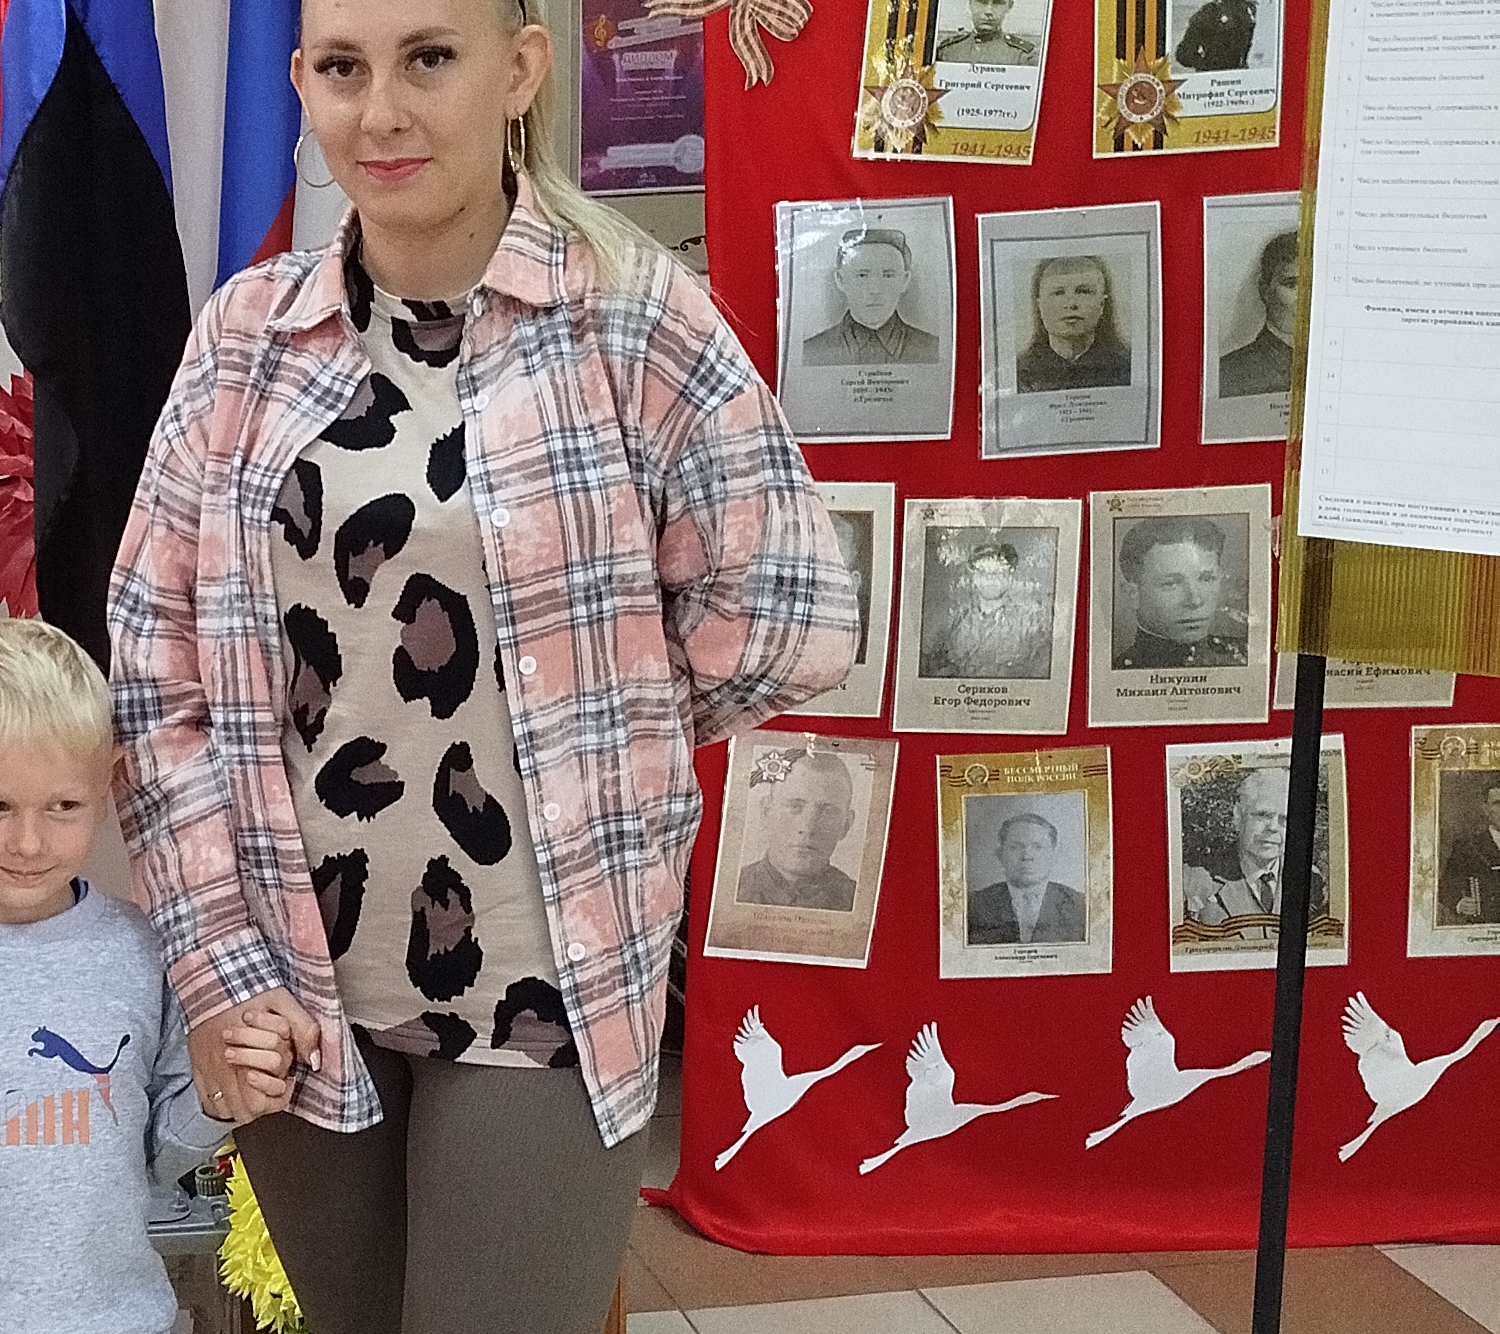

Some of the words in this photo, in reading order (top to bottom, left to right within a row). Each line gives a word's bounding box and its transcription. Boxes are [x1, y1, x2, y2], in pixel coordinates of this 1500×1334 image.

[939, 79, 982, 89] Григорий
[984, 81, 1031, 91] Сергеевич
[1177, 91, 1225, 100] Митрофан
[1227, 88, 1275, 98] Сергеевич
[1194, 126, 1276, 144] 1941-1945
[952, 142, 1032, 159] 1941-1945
[1325, 668, 1362, 676] насий
[1366, 667, 1430, 678] Ефимович
[1149, 674, 1207, 685] Никулин
[957, 684, 1008, 695] Сериков
[1116, 688, 1167, 697] Михаил
[1170, 686, 1241, 696] Антонович
[934, 696, 961, 707] Егор
[964, 696, 1030, 708] Федорович
[1036, 773, 1077, 782] РОССИИ
